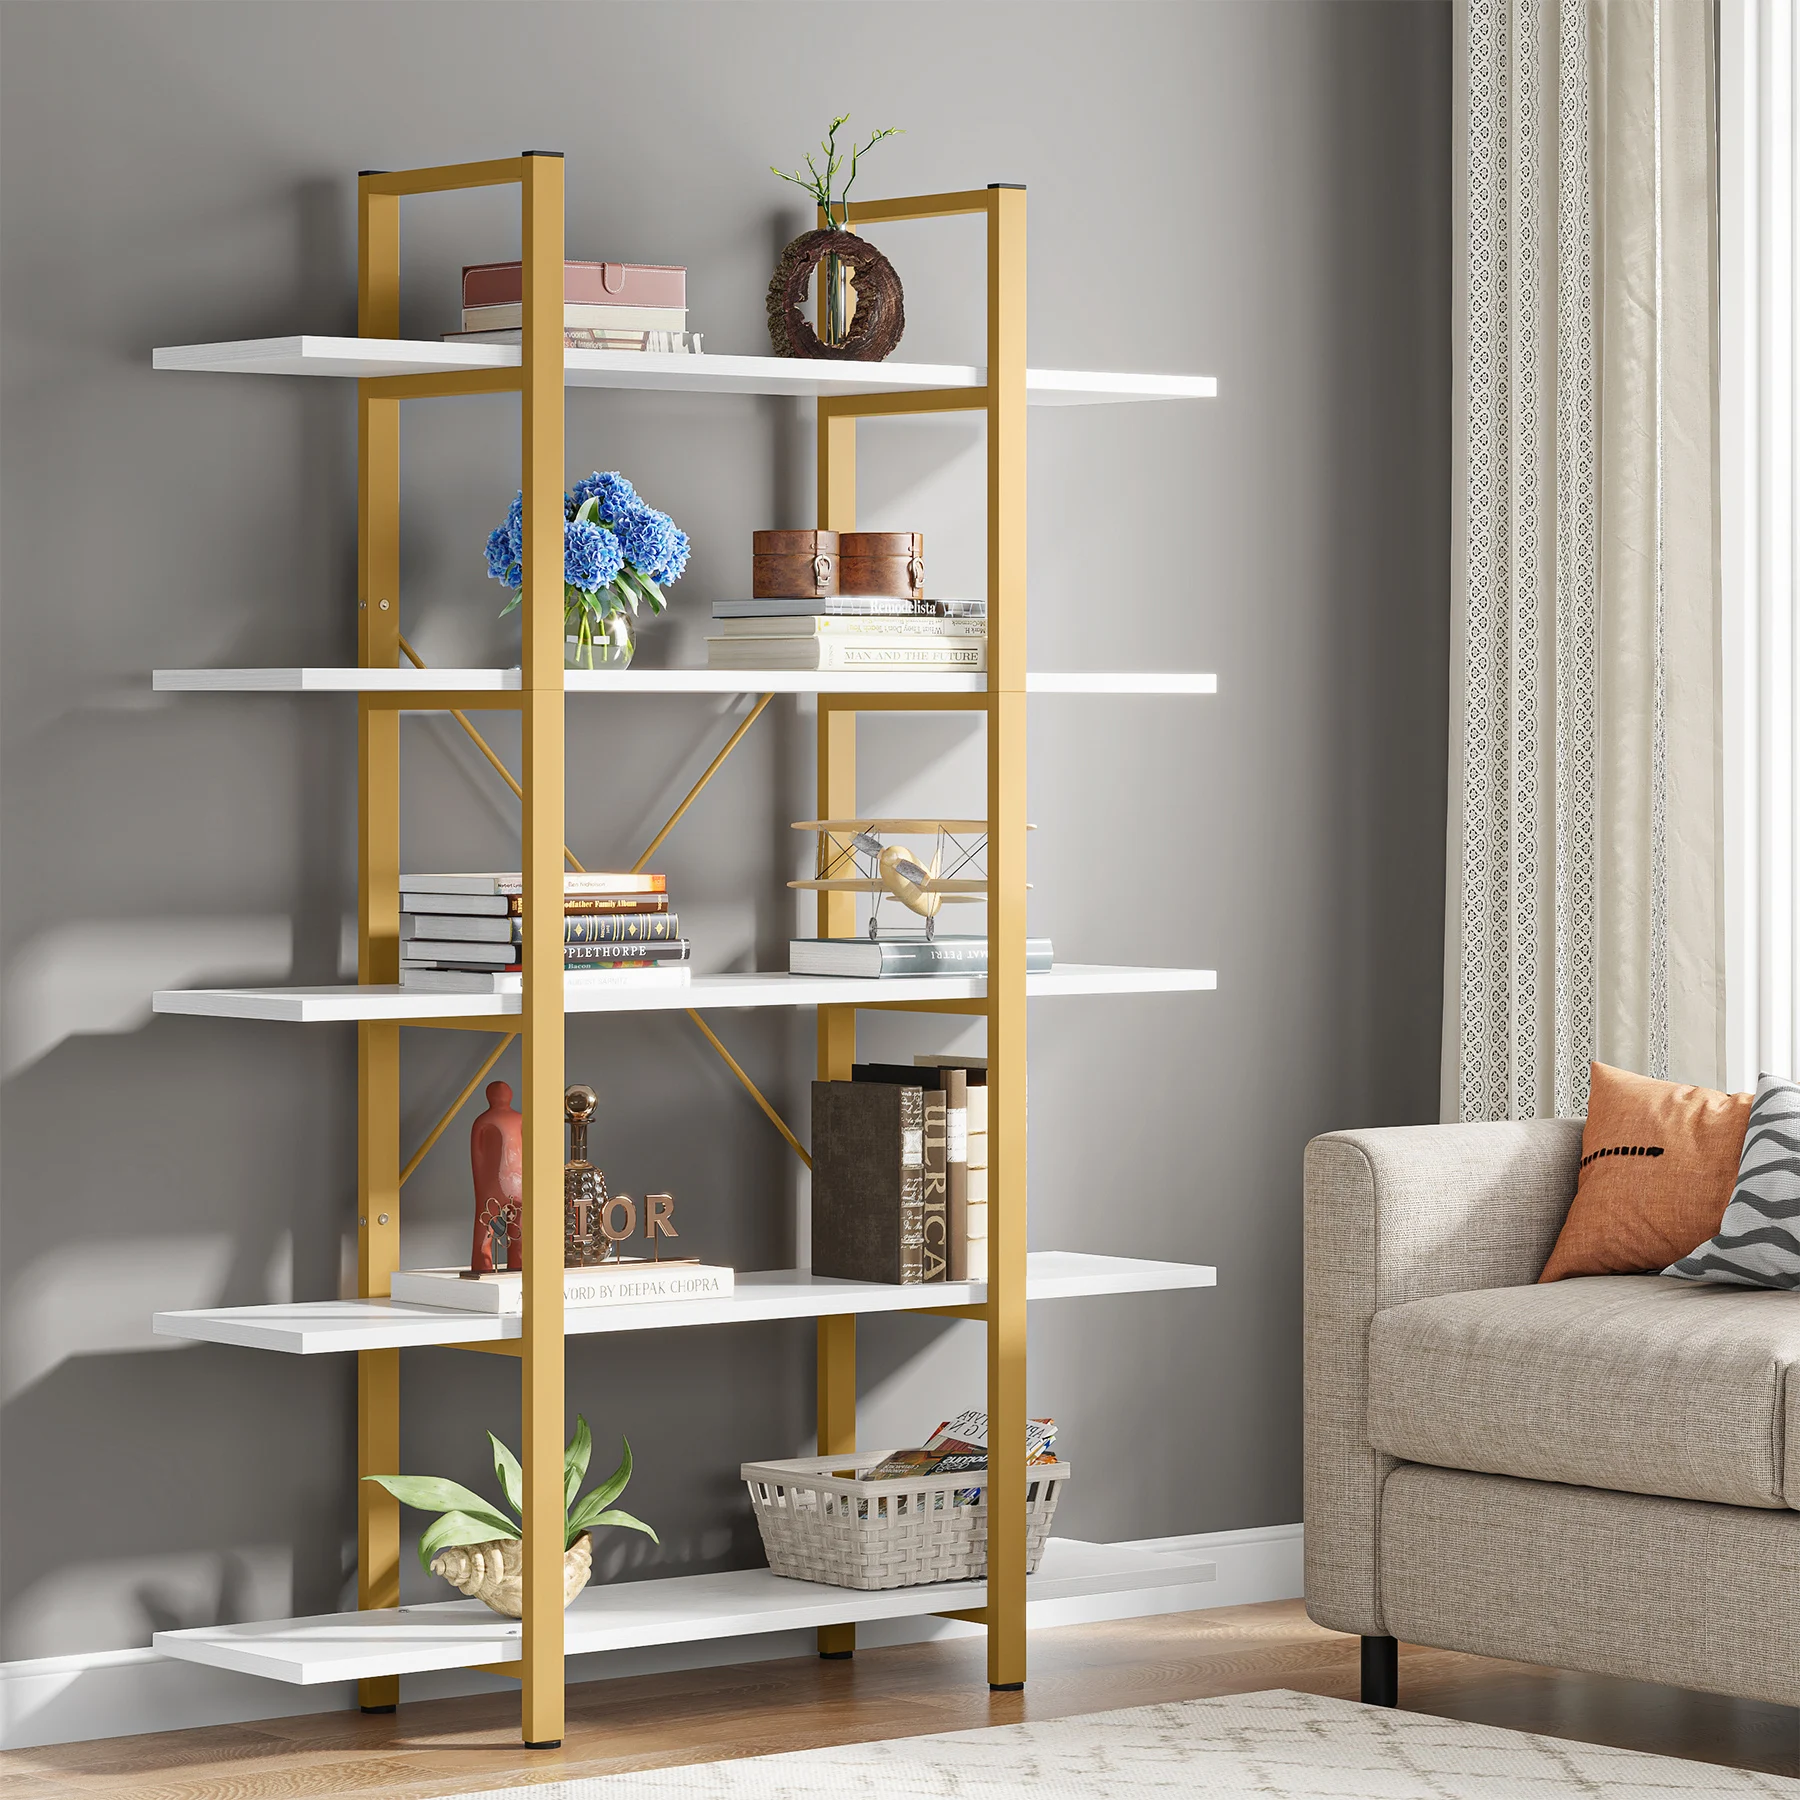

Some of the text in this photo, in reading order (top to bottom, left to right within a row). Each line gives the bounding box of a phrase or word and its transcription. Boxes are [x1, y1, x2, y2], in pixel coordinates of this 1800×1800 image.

[871, 600, 936, 614] Remodelista
[904, 625, 921, 634] They
[844, 652, 978, 661] MAN AND THE FUTURE
[564, 899, 637, 908] odfather Family Album
[931, 951, 964, 961] PETRI
[924, 1104, 946, 1281] ULRICA
[573, 1194, 679, 1243] IOR
[600, 1284, 616, 1298] BY
[619, 1281, 666, 1297] DEEPAK
[670, 1277, 719, 1294] CHOPRA
